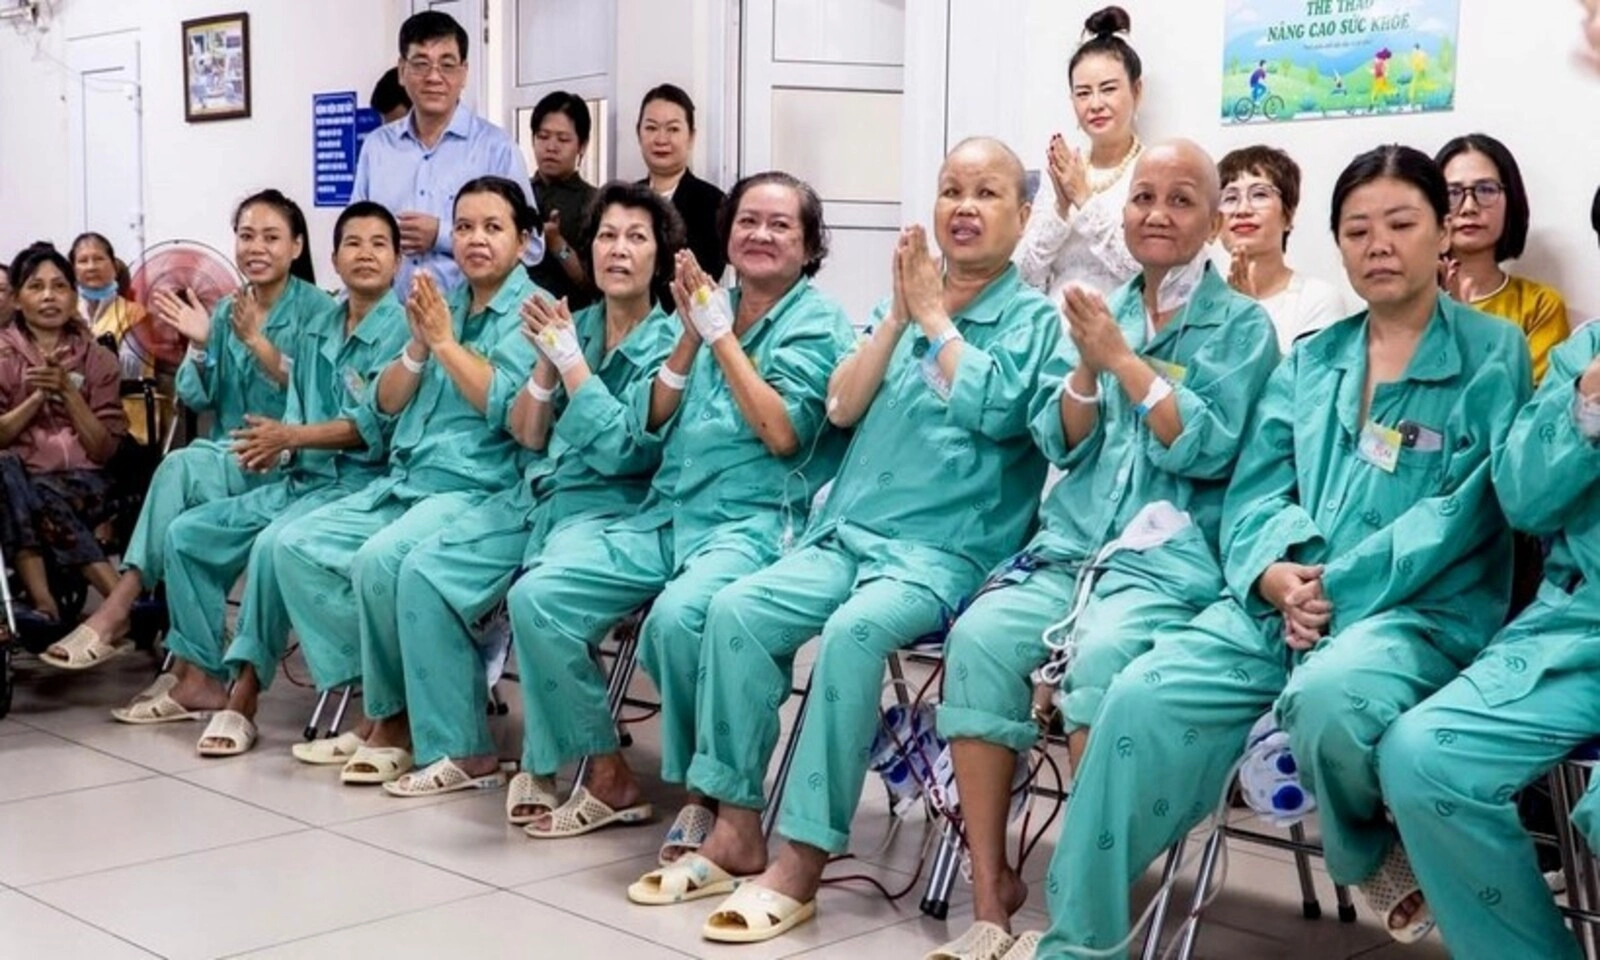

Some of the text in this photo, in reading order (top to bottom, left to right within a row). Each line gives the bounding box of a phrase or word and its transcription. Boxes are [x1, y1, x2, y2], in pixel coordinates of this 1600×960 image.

[1267, 20, 1305, 42] NÂNG
[1308, 20, 1337, 38] CAO
[1339, 14, 1366, 35] SỨC
